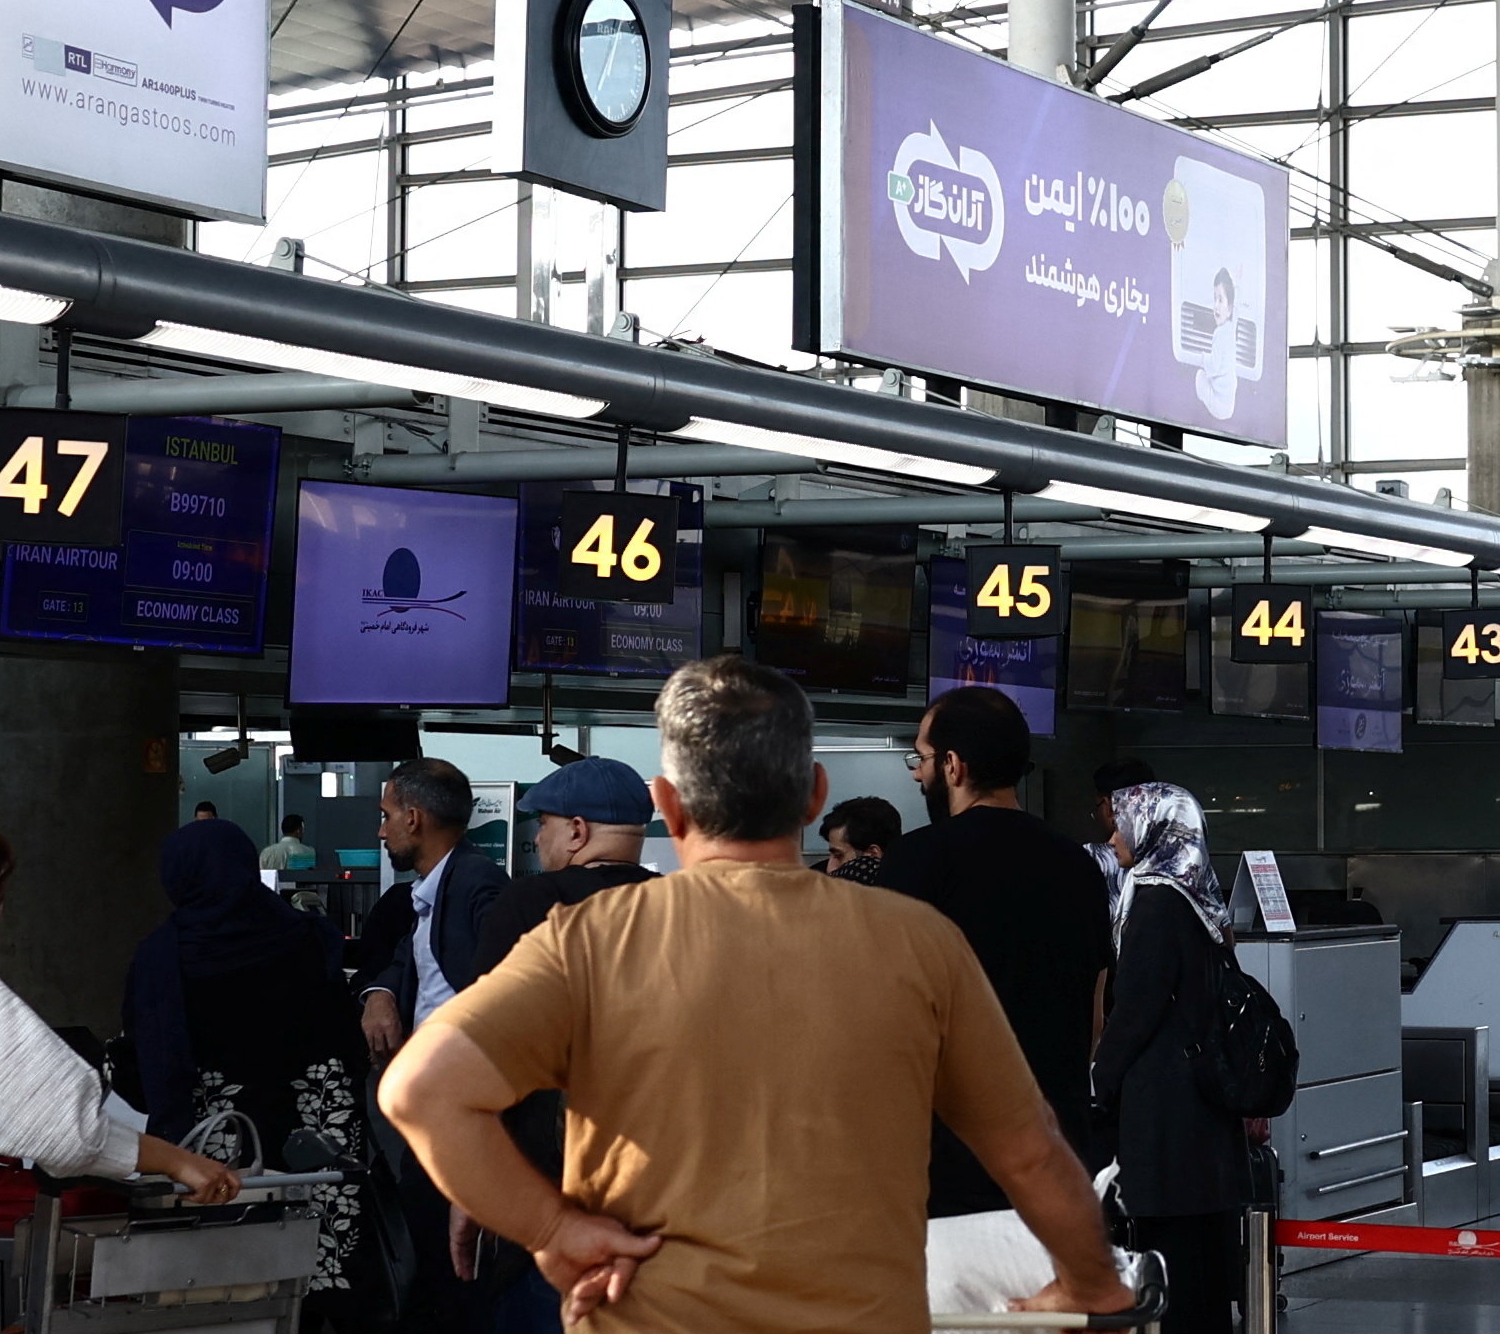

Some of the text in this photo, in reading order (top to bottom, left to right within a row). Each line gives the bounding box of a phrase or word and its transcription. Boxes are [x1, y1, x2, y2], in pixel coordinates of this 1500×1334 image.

[67, 51, 89, 69] RTL
[141, 76, 197, 102] AR1400PLUS
[21, 77, 237, 147] www.arangastoos.com
[1024, 170, 1083, 233] ایمن
[1025, 253, 1150, 324] بخاری هوشمند
[165, 435, 239, 466] ISTANBUL
[170, 491, 226, 519] B99710
[15, 543, 119, 571] IRAN AIRTOUR
[570, 513, 662, 583] 46
[172, 559, 213, 583] 09:00
[361, 588, 384, 598] IKAC
[525, 588, 550, 607] IRAN
[976, 563, 1052, 619] 45
[72, 600, 85, 615] 13
[136, 600, 240, 626] ECONOMY CLASS
[1240, 599, 1306, 647] 44
[610, 633, 684, 653] ECONOMY CLASS
[1297, 1230, 1360, 1243] Airport Service
